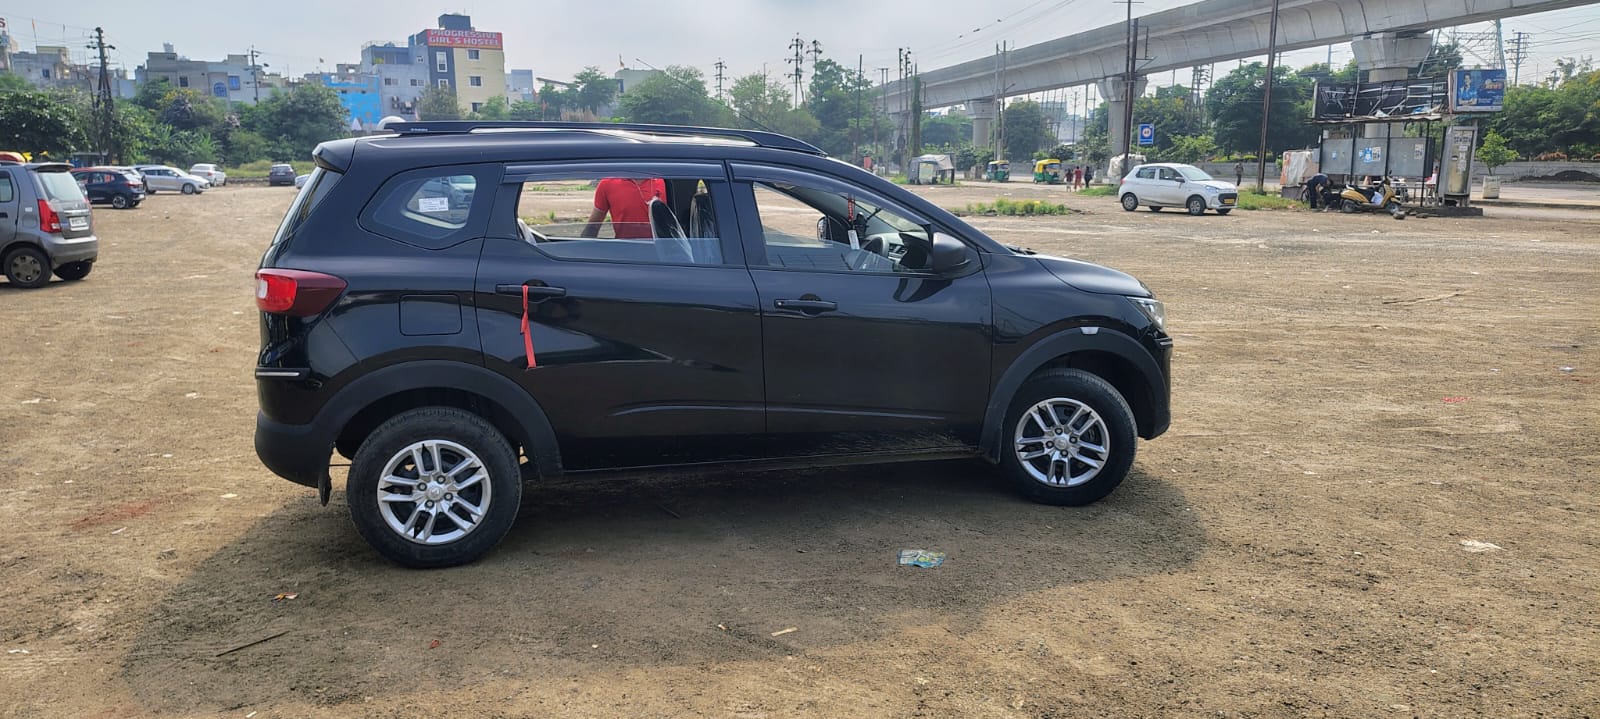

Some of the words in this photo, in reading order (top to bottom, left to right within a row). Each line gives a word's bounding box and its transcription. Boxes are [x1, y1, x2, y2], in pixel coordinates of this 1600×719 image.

[430, 29, 497, 39] PROGRESSIVE
[429, 36, 462, 45] GIRL'S
[463, 37, 499, 46] HOSTEL
